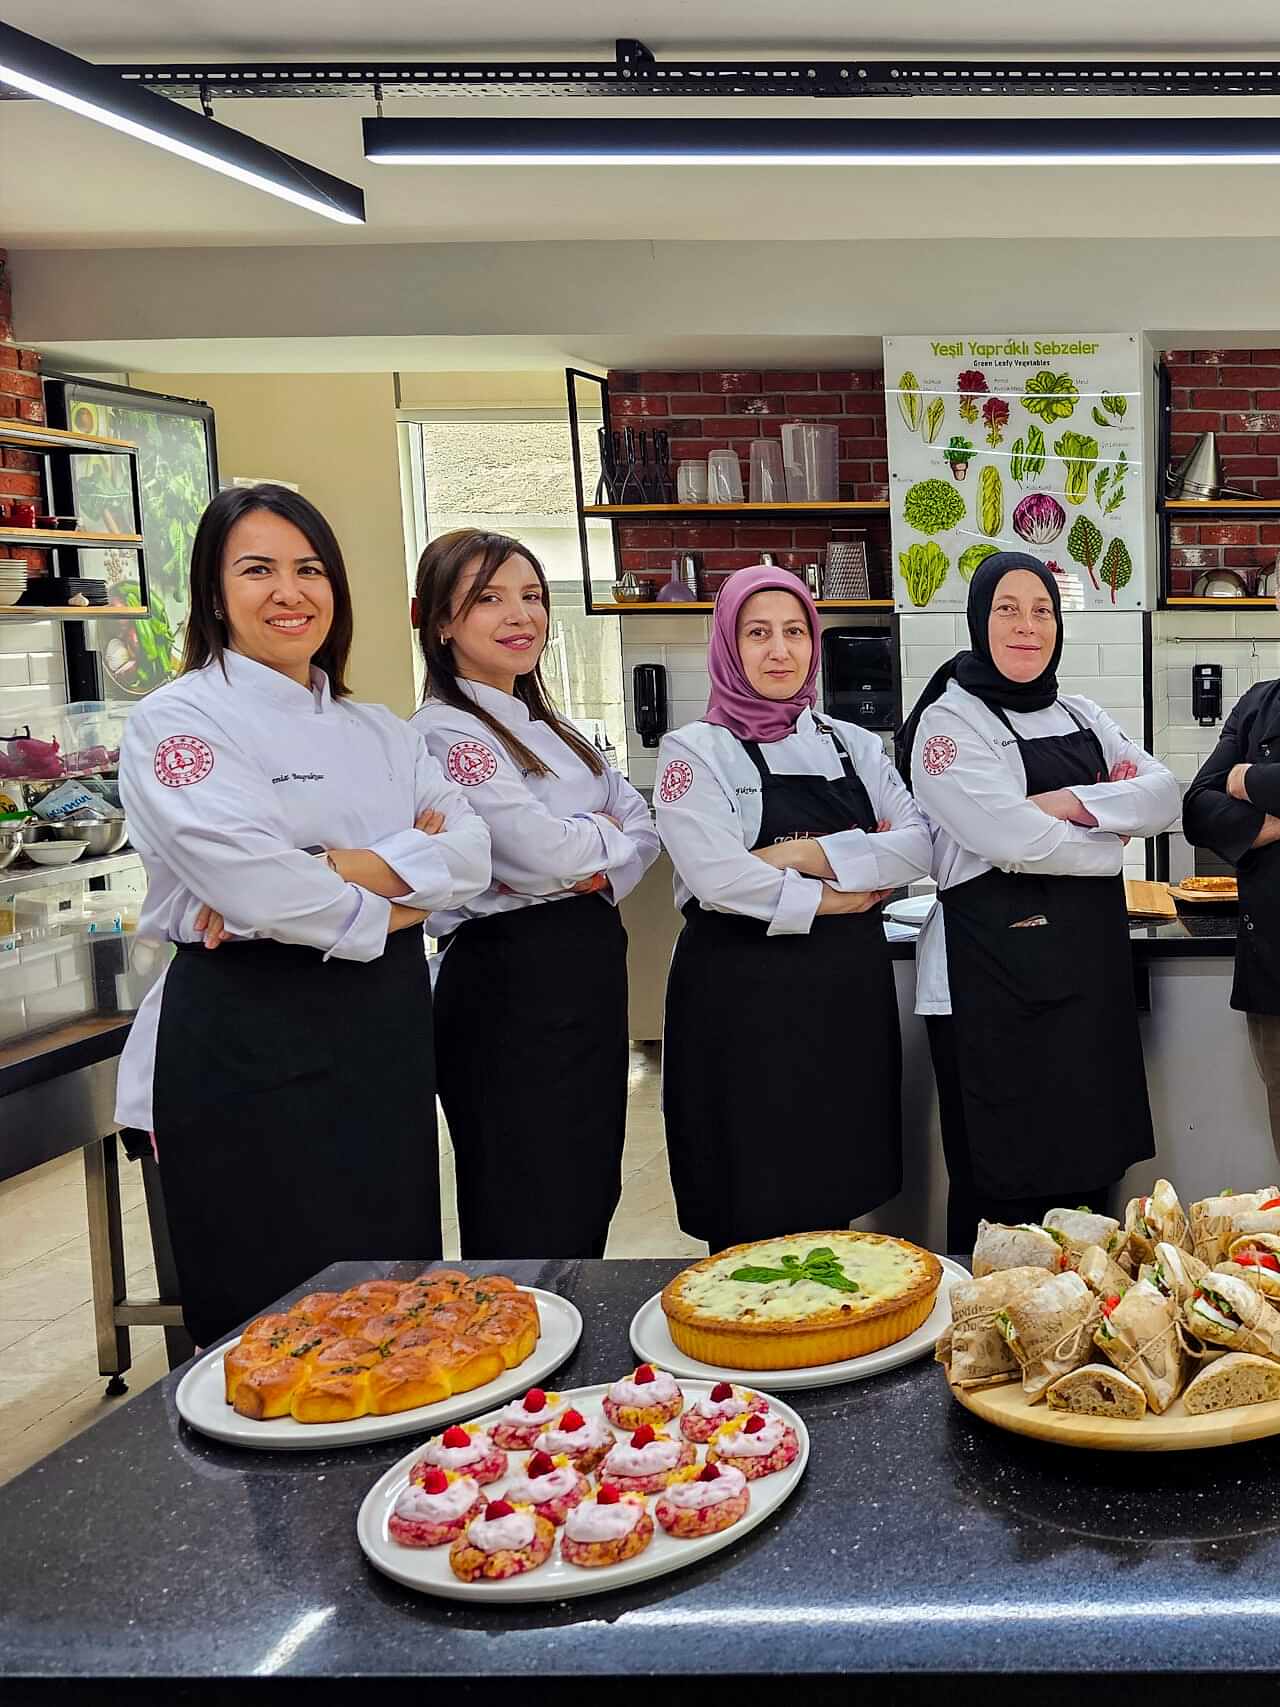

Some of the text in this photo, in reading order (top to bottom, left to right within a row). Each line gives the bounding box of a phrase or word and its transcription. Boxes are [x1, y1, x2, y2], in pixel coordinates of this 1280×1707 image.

[930, 341, 1099, 358] Yeşil Yapraklı Sebzeler
[994, 360, 1013, 368] Leafy
[1014, 359, 1050, 368] Vegetables
